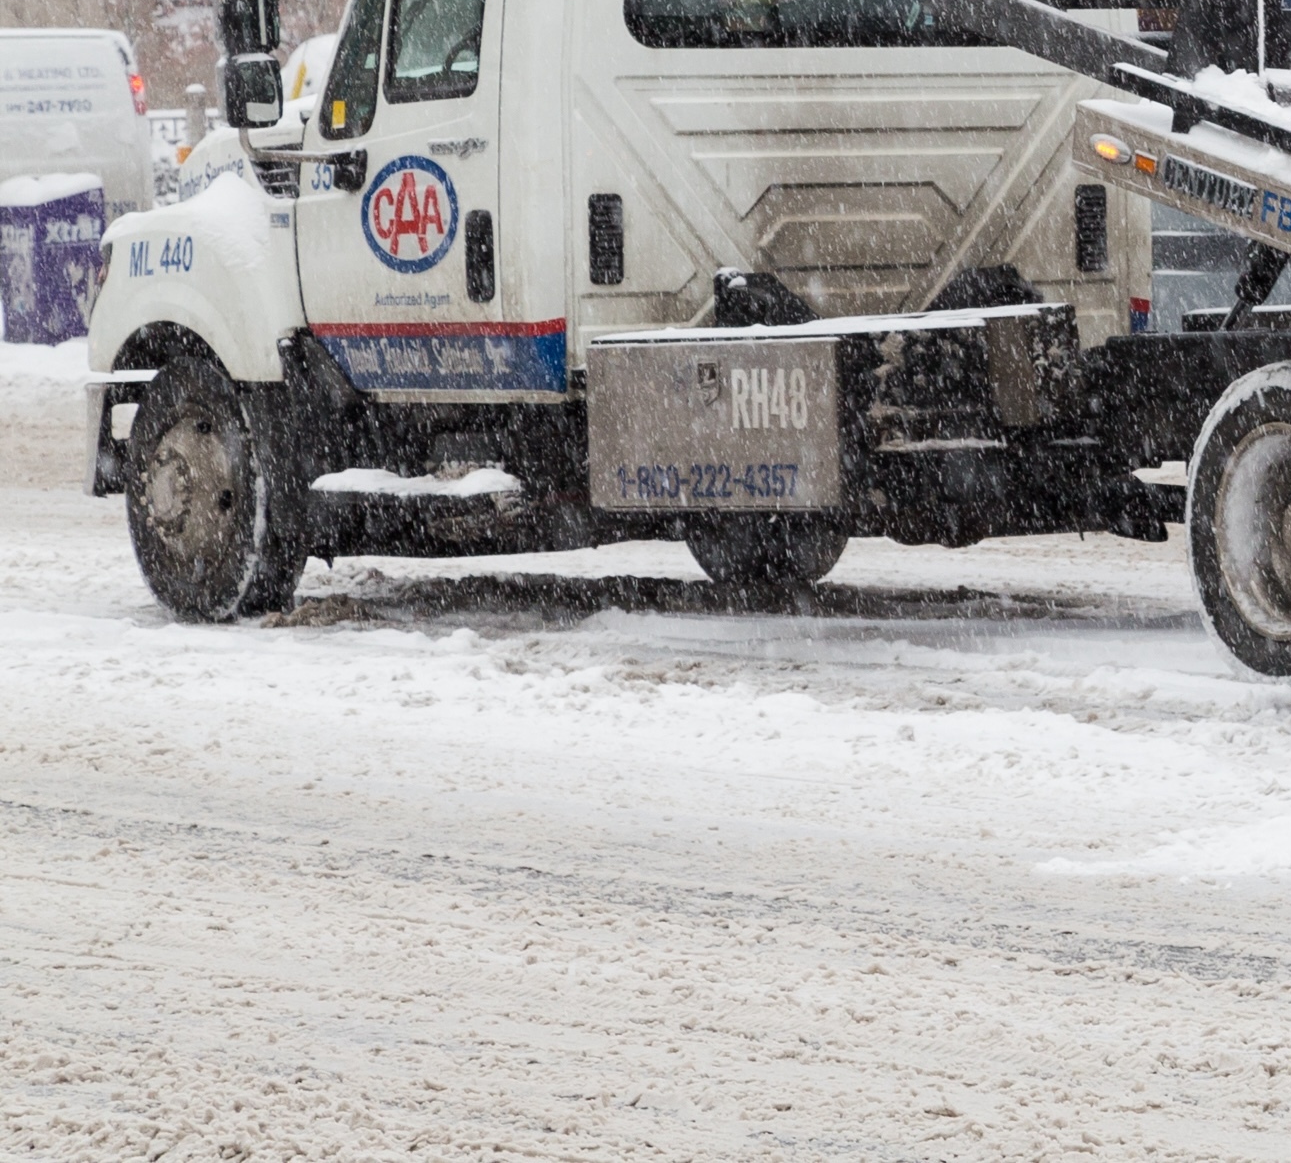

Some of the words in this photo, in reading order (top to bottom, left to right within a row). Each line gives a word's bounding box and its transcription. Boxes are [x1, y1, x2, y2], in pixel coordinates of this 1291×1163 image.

[373, 172, 444, 256] CAA
[129, 241, 154, 278] ML
[160, 235, 193, 273] 440
[375, 293, 422, 307] Authorized
[424, 293, 451, 309] Agent
[731, 368, 808, 429] RH48
[617, 463, 799, 498] 1-800-222-4357
